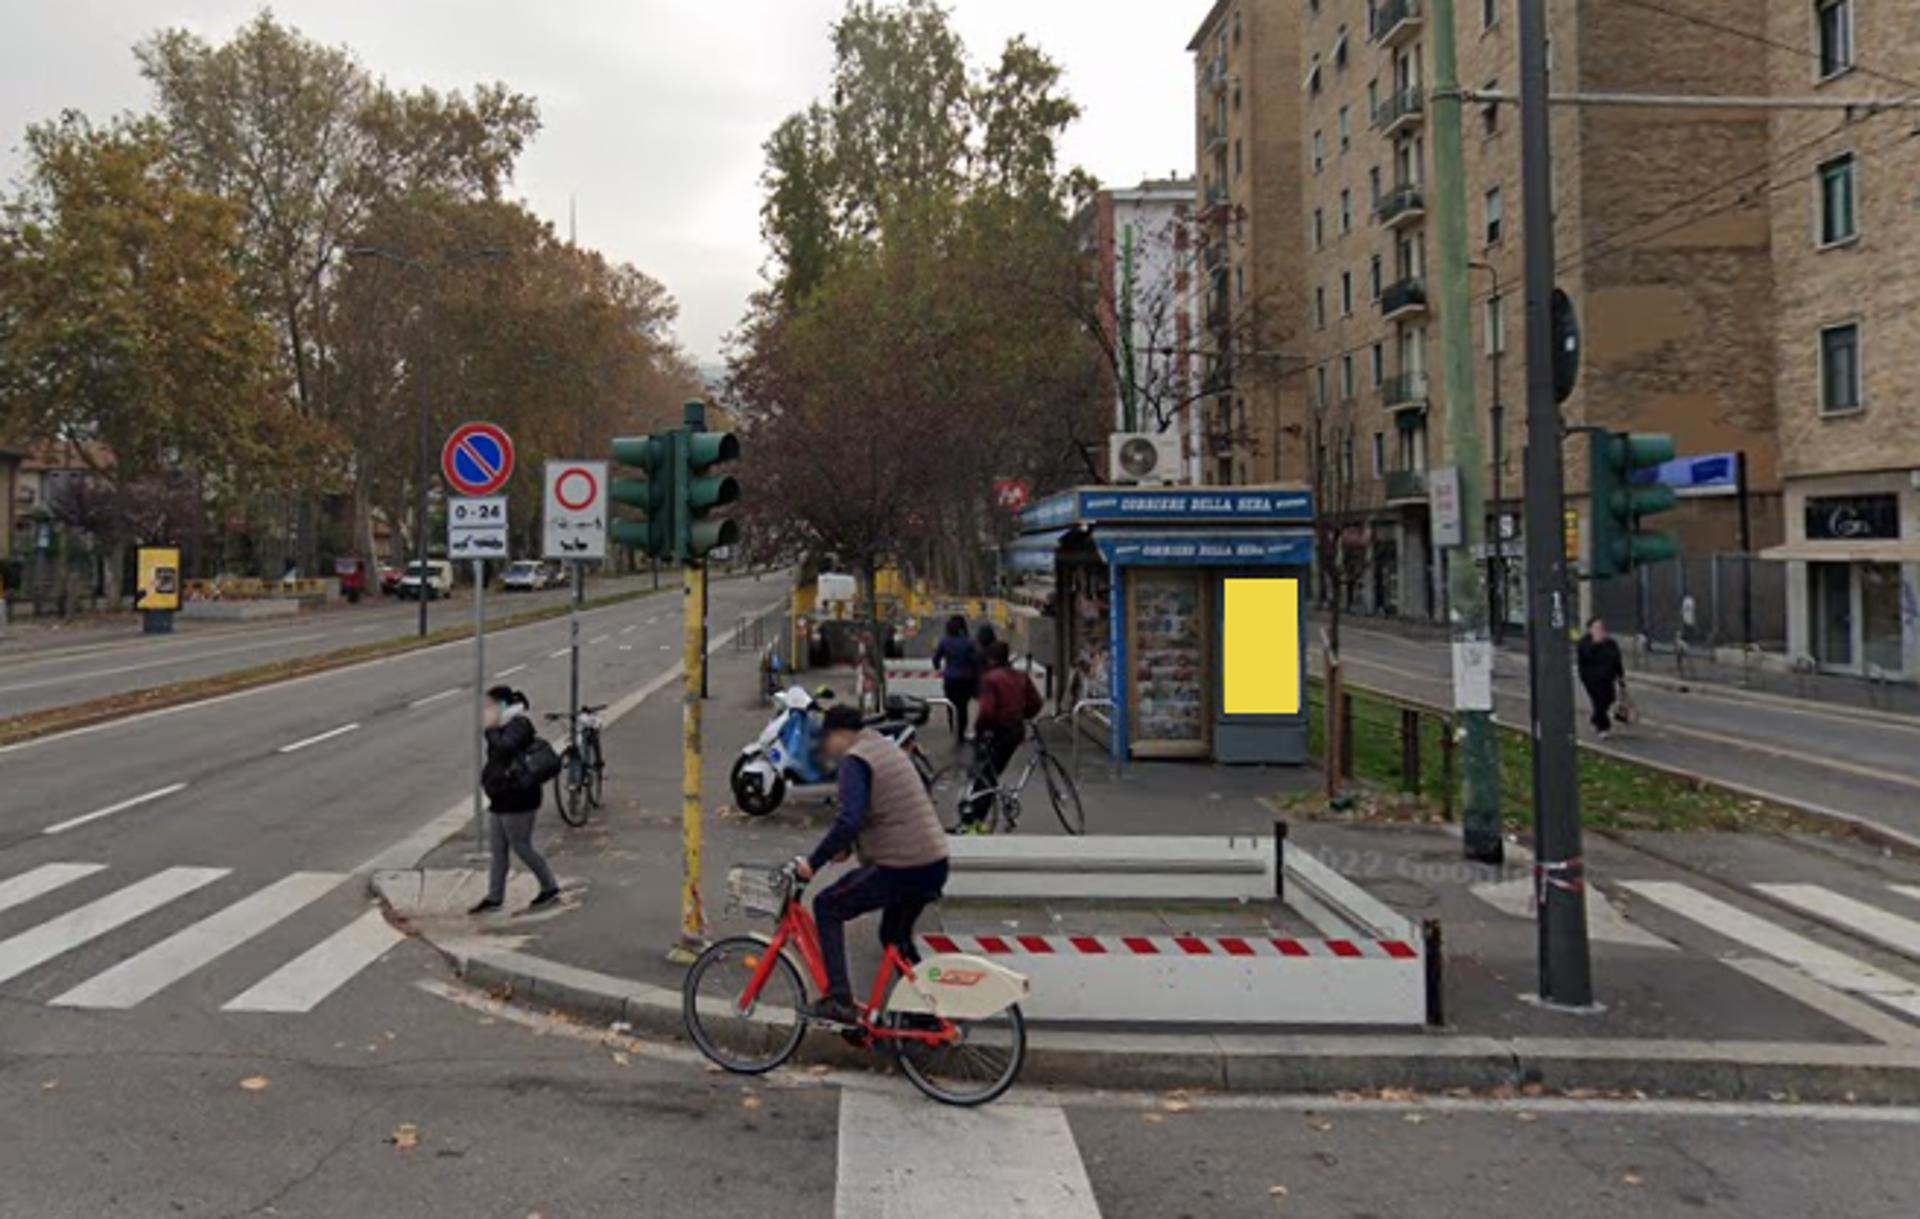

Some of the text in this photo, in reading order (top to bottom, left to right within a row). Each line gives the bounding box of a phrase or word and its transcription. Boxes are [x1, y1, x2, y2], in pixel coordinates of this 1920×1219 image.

[1121, 498, 1271, 511] CORRIERE DELLA SERA
[455, 505, 467, 518] 0
[479, 505, 499, 519] 24
[1142, 545, 1263, 556] CORRIERE DELLA SERA
